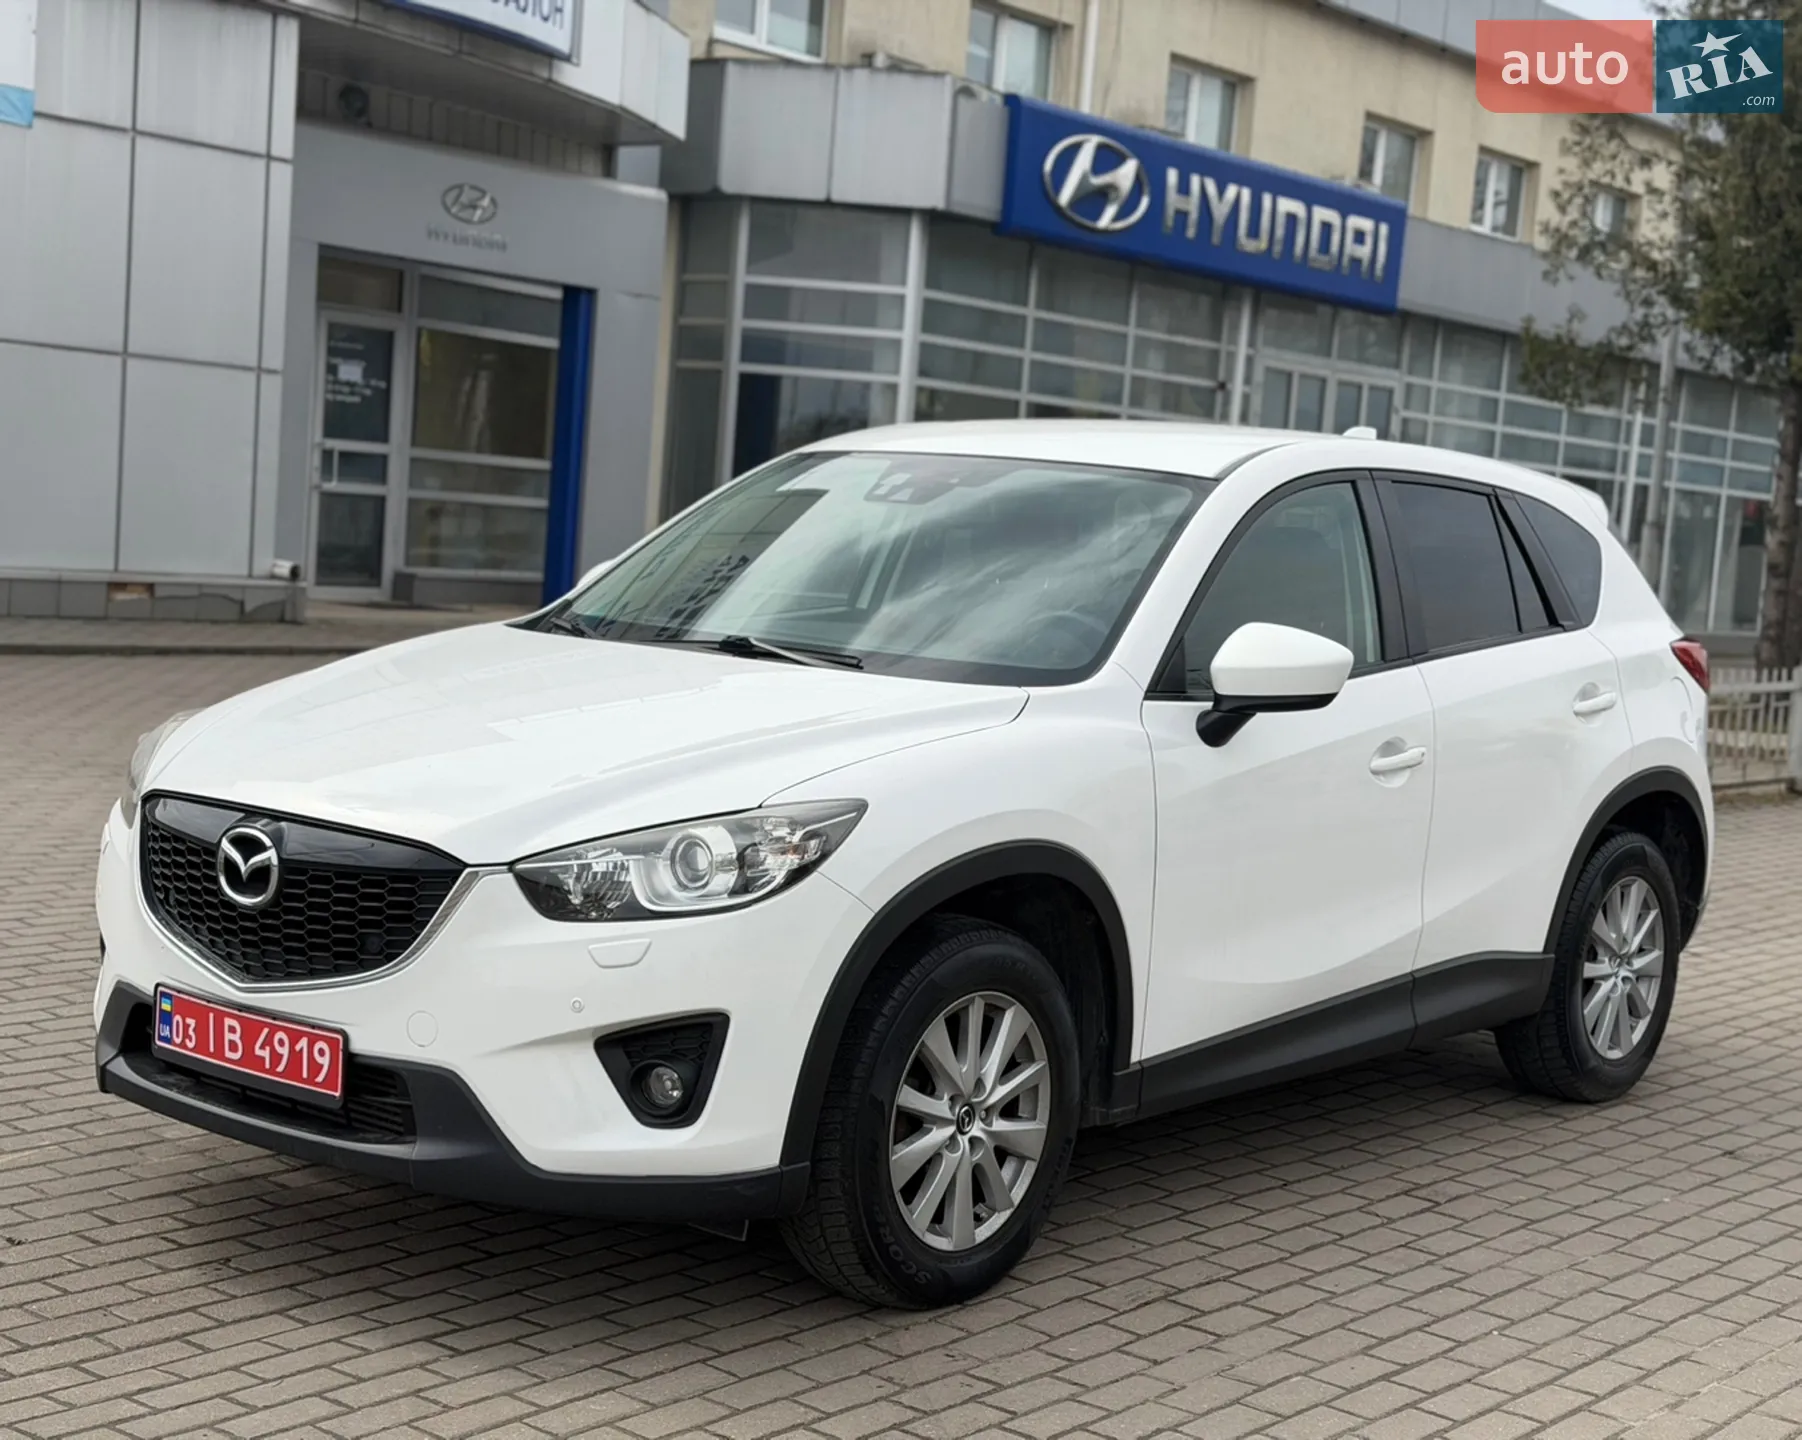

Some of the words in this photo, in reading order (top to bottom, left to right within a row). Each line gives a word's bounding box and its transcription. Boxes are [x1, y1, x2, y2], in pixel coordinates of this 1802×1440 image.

[1163, 166, 1390, 282] HYUNDAI
[159, 1023, 171, 1038] UA
[172, 1014, 197, 1049] 03
[254, 1027, 331, 1083] 4919
